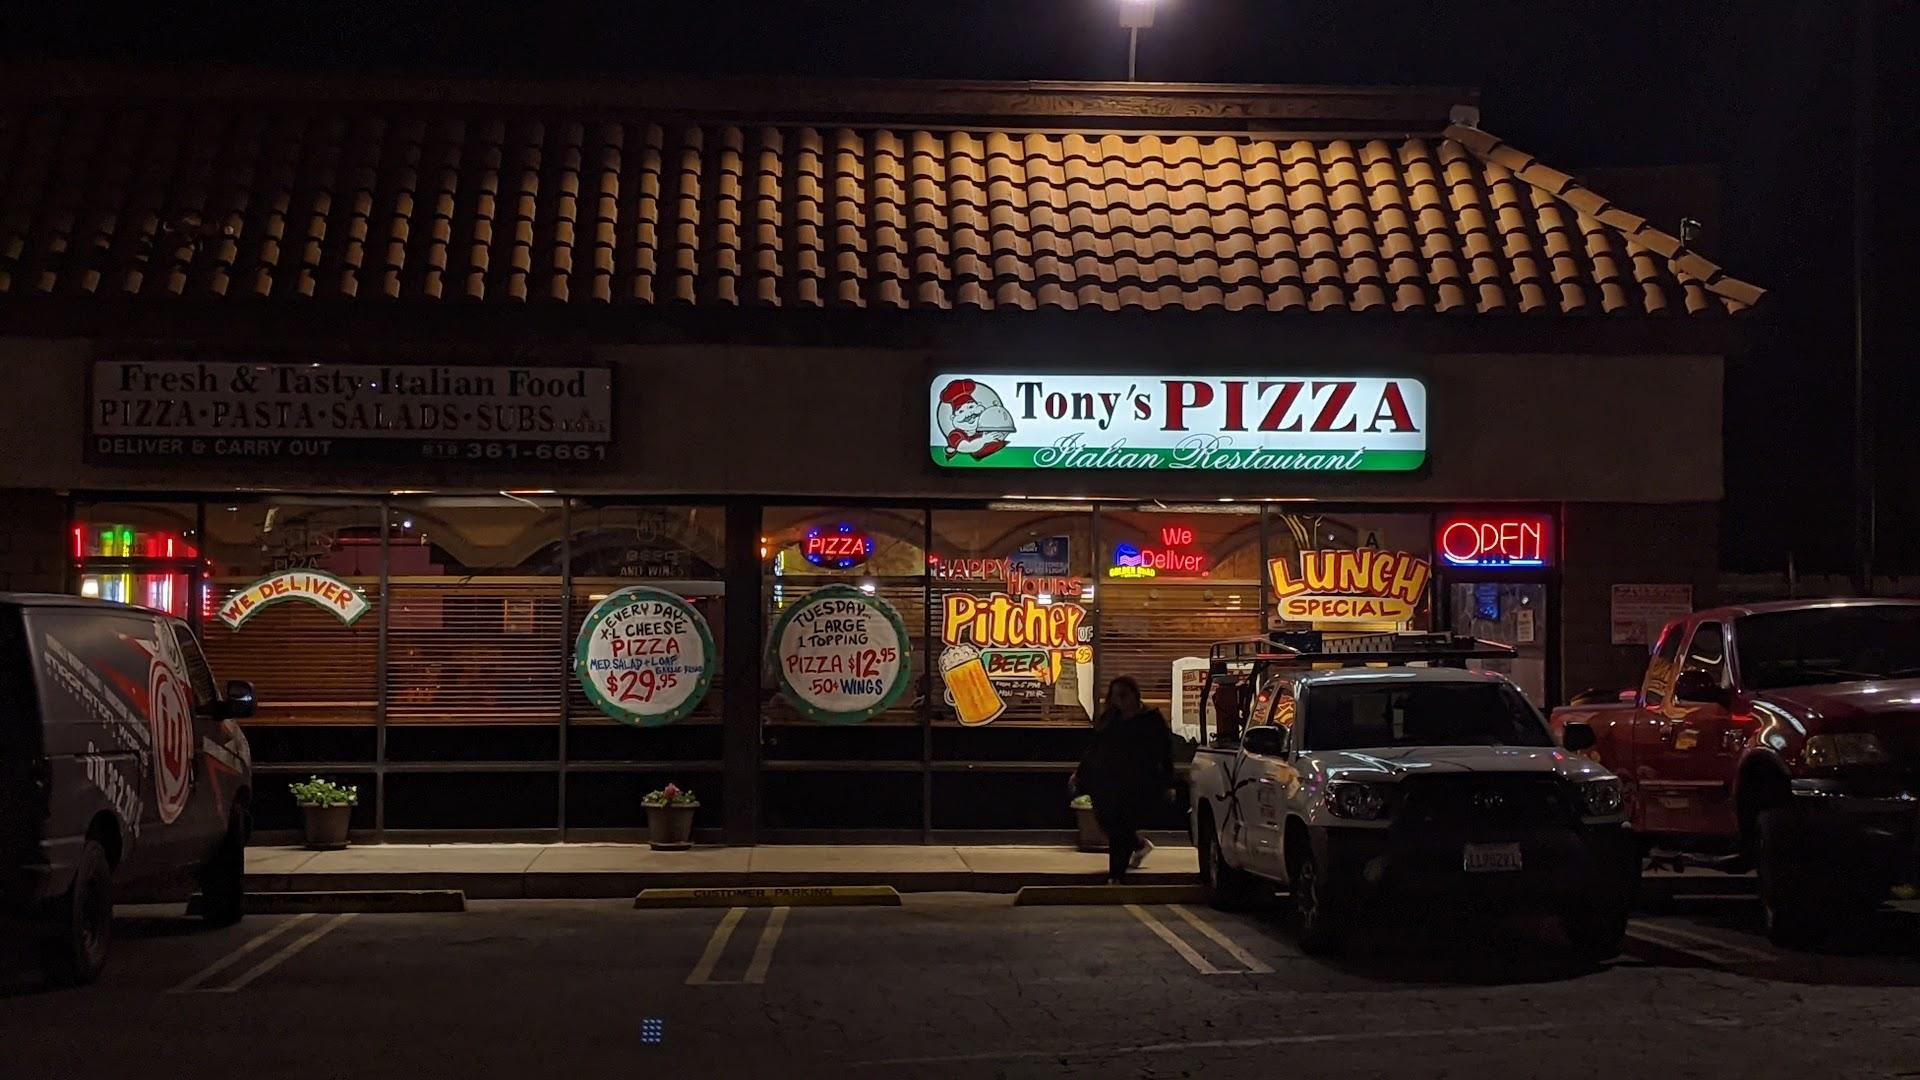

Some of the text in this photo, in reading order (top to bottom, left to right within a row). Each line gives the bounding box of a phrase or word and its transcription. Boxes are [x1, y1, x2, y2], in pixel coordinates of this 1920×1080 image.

[120, 364, 587, 401] Fresh & Tasty Italian Food
[1015, 380, 1421, 433] Tony's PIZZA
[99, 438, 184, 455] DELIVER
[215, 440, 282, 456] CARRY
[289, 440, 334, 456] OUT
[466, 442, 606, 460] 361-6661
[1033, 432, 1368, 470] Italian Restaurant
[809, 537, 865, 555] PIZZA
[1162, 527, 1193, 546] We
[1443, 522, 1541, 560] OPEN
[936, 557, 1009, 581] HAPPY
[1269, 549, 1432, 606] LUNCH
[1007, 570, 1084, 596] HOURS
[221, 575, 354, 621] WE DELIVER
[1288, 599, 1401, 617] SPECIAL
[606, 603, 650, 629] EVERY
[813, 619, 868, 634] LARGE
[943, 593, 1086, 648] Pitcher
[625, 619, 686, 638] CHEESE
[611, 636, 680, 658] PIZZA
[799, 633, 869, 648] 1 TOPPING
[786, 647, 897, 678] PIZZA $12.95
[988, 653, 1045, 674] BEER
[606, 669, 678, 703] $29.95
[839, 678, 884, 696] WINGS
[694, 887, 833, 898] CUSTOMER PARKING
